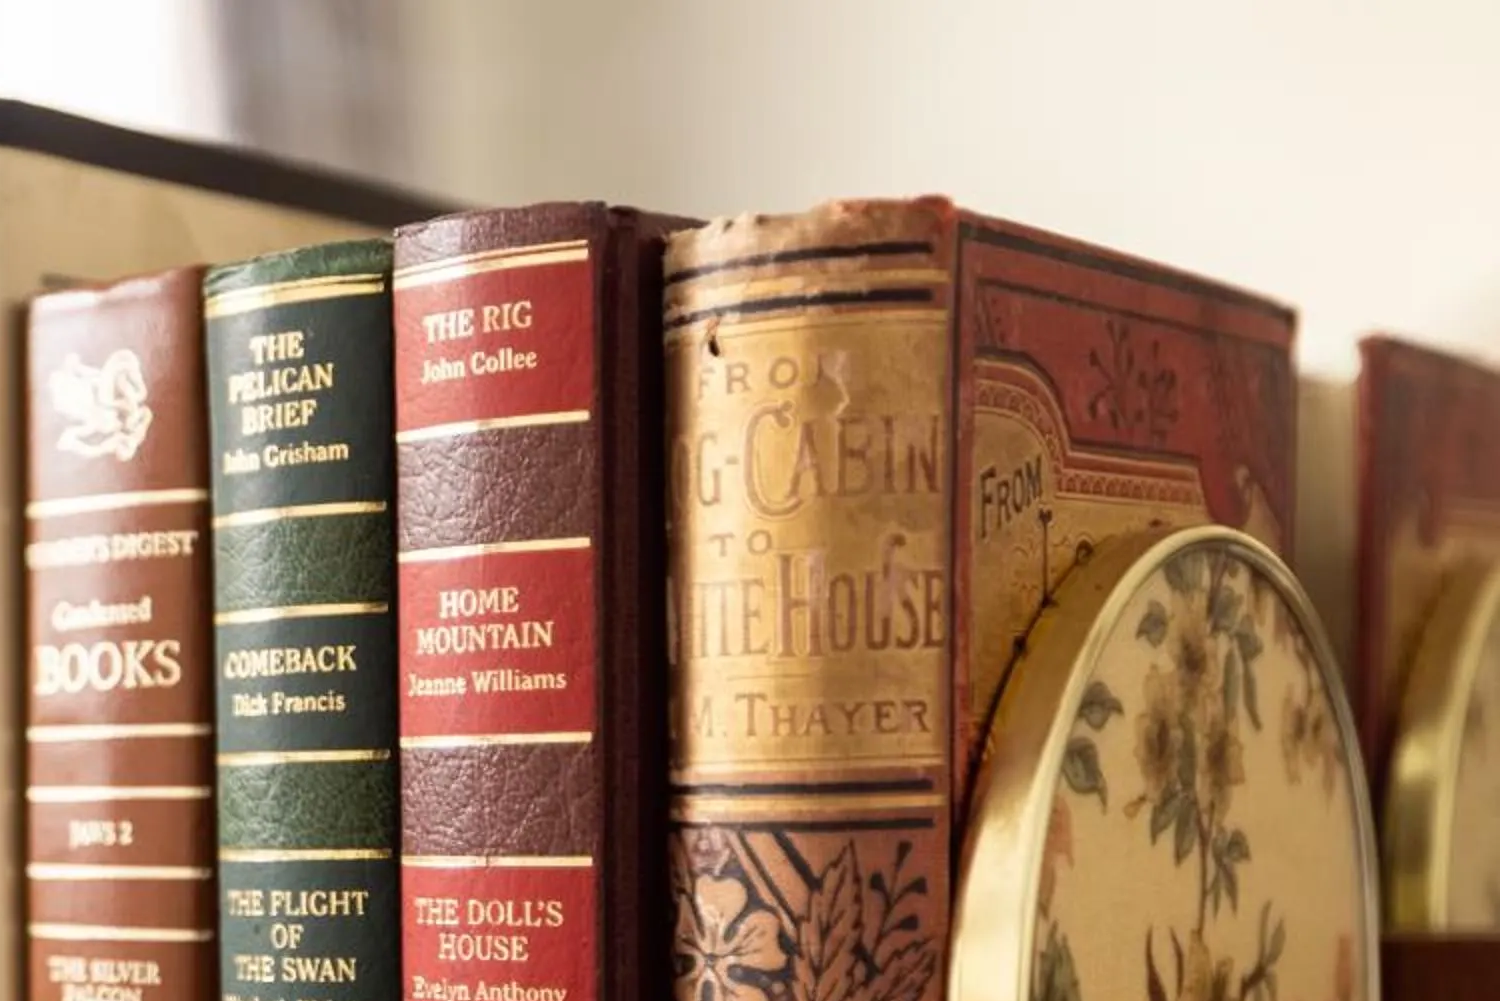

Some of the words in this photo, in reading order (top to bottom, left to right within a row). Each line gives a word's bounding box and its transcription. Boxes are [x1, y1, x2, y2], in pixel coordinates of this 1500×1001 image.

[422, 307, 475, 344] THE
[482, 300, 533, 333] RIG
[249, 331, 304, 365] THE
[228, 362, 335, 403] PELICAN
[420, 356, 466, 385] John
[470, 347, 538, 375] Collee
[697, 356, 846, 400] FRO
[241, 399, 317, 436] BRIEF
[223, 449, 261, 475] John
[262, 440, 350, 468] Grisham
[978, 456, 1044, 540] FROM
[111, 530, 199, 560] DIGEST
[708, 529, 770, 558] TO
[438, 586, 520, 619] HOME
[776, 533, 946, 660] HOUSE
[415, 620, 555, 656] MOUNTAIN
[32, 639, 183, 697] BOOKS
[223, 645, 358, 680] COMEBACK
[407, 672, 467, 698] Jeanne
[471, 668, 568, 694] Williams
[231, 692, 268, 718] Dick
[270, 690, 347, 715] Francis
[734, 691, 930, 738] THAYER
[68, 819, 117, 852] JAWS
[118, 819, 134, 846] 2
[227, 889, 265, 917] THE
[268, 890, 368, 917] FLIGHT
[414, 897, 460, 925] THE
[466, 899, 564, 928] DOLL'S
[270, 923, 304, 950] OF
[437, 933, 529, 962] HOUSE
[47, 954, 88, 983] THE
[233, 954, 276, 983] THE
[280, 957, 357, 983] SWAN
